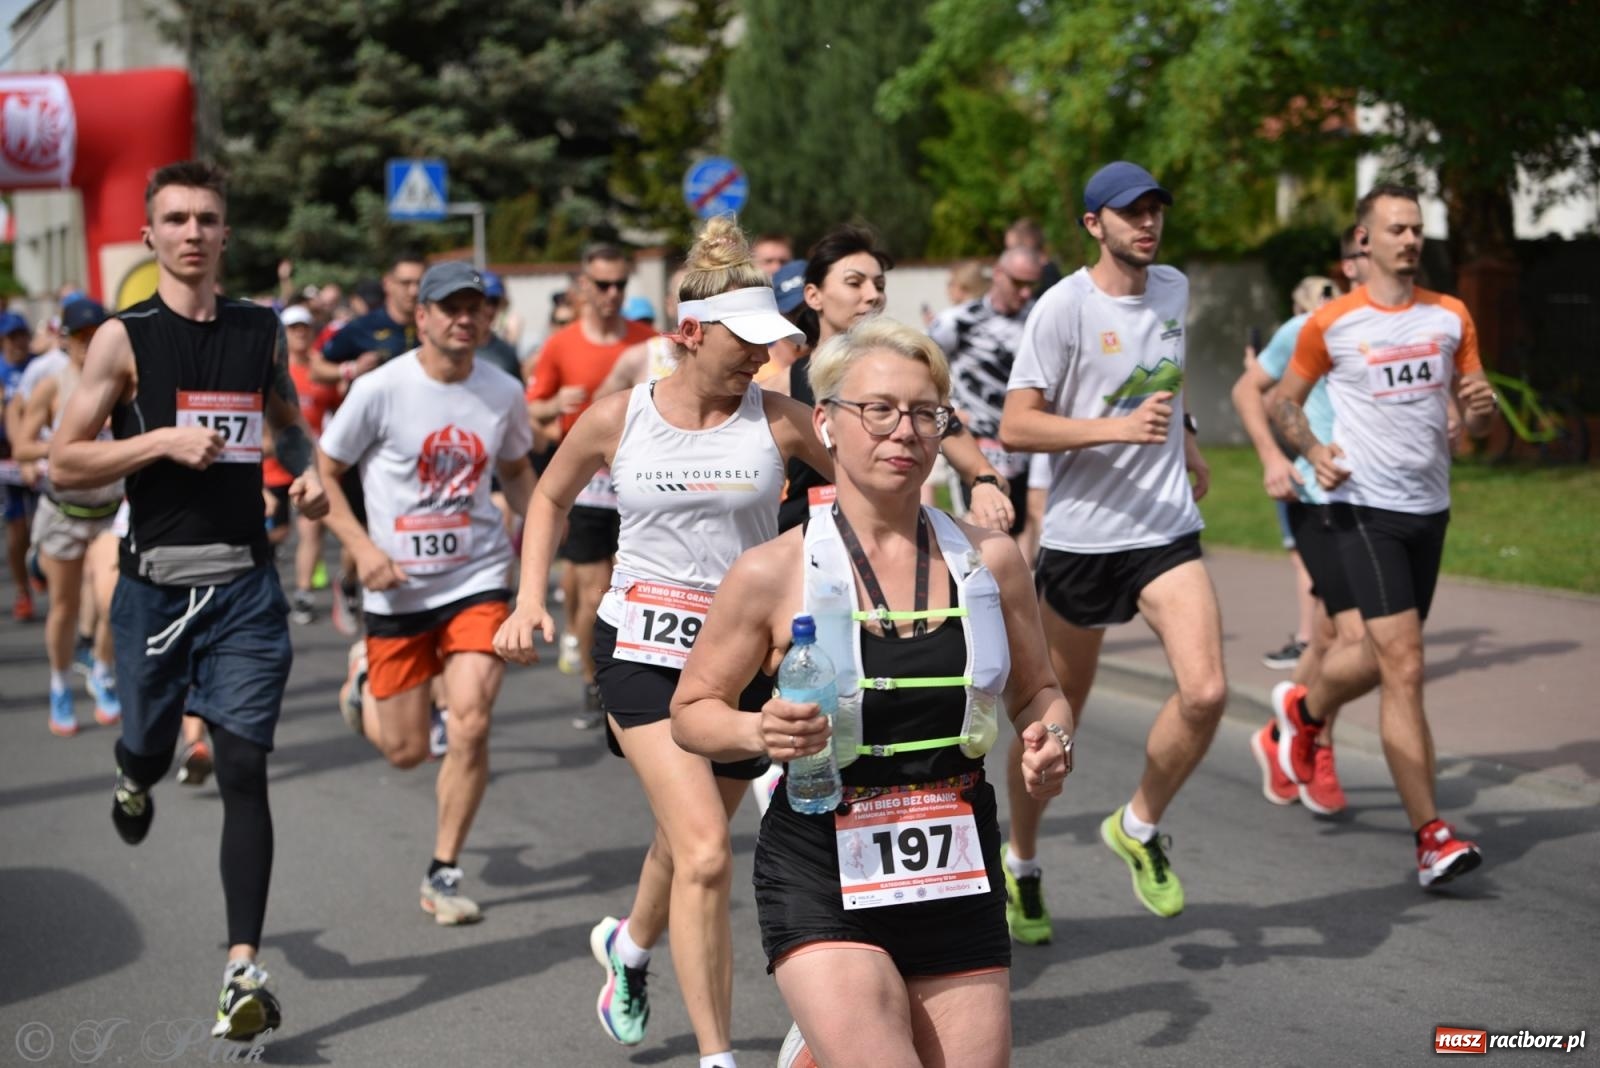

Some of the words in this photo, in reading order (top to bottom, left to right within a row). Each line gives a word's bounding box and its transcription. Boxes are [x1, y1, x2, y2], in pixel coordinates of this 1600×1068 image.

[1383, 361, 1432, 387] 144
[636, 471, 673, 480] PUSH
[683, 470, 760, 479] YOURSELF
[411, 533, 457, 557] 130
[638, 585, 651, 594] XVI
[670, 589, 686, 600] BEZ
[643, 609, 702, 648] 129
[852, 801, 873, 813] XVI
[875, 798, 901, 810] BIEG
[902, 795, 923, 806] BEZ
[923, 792, 957, 804] GRANIC
[872, 823, 952, 875] 197
